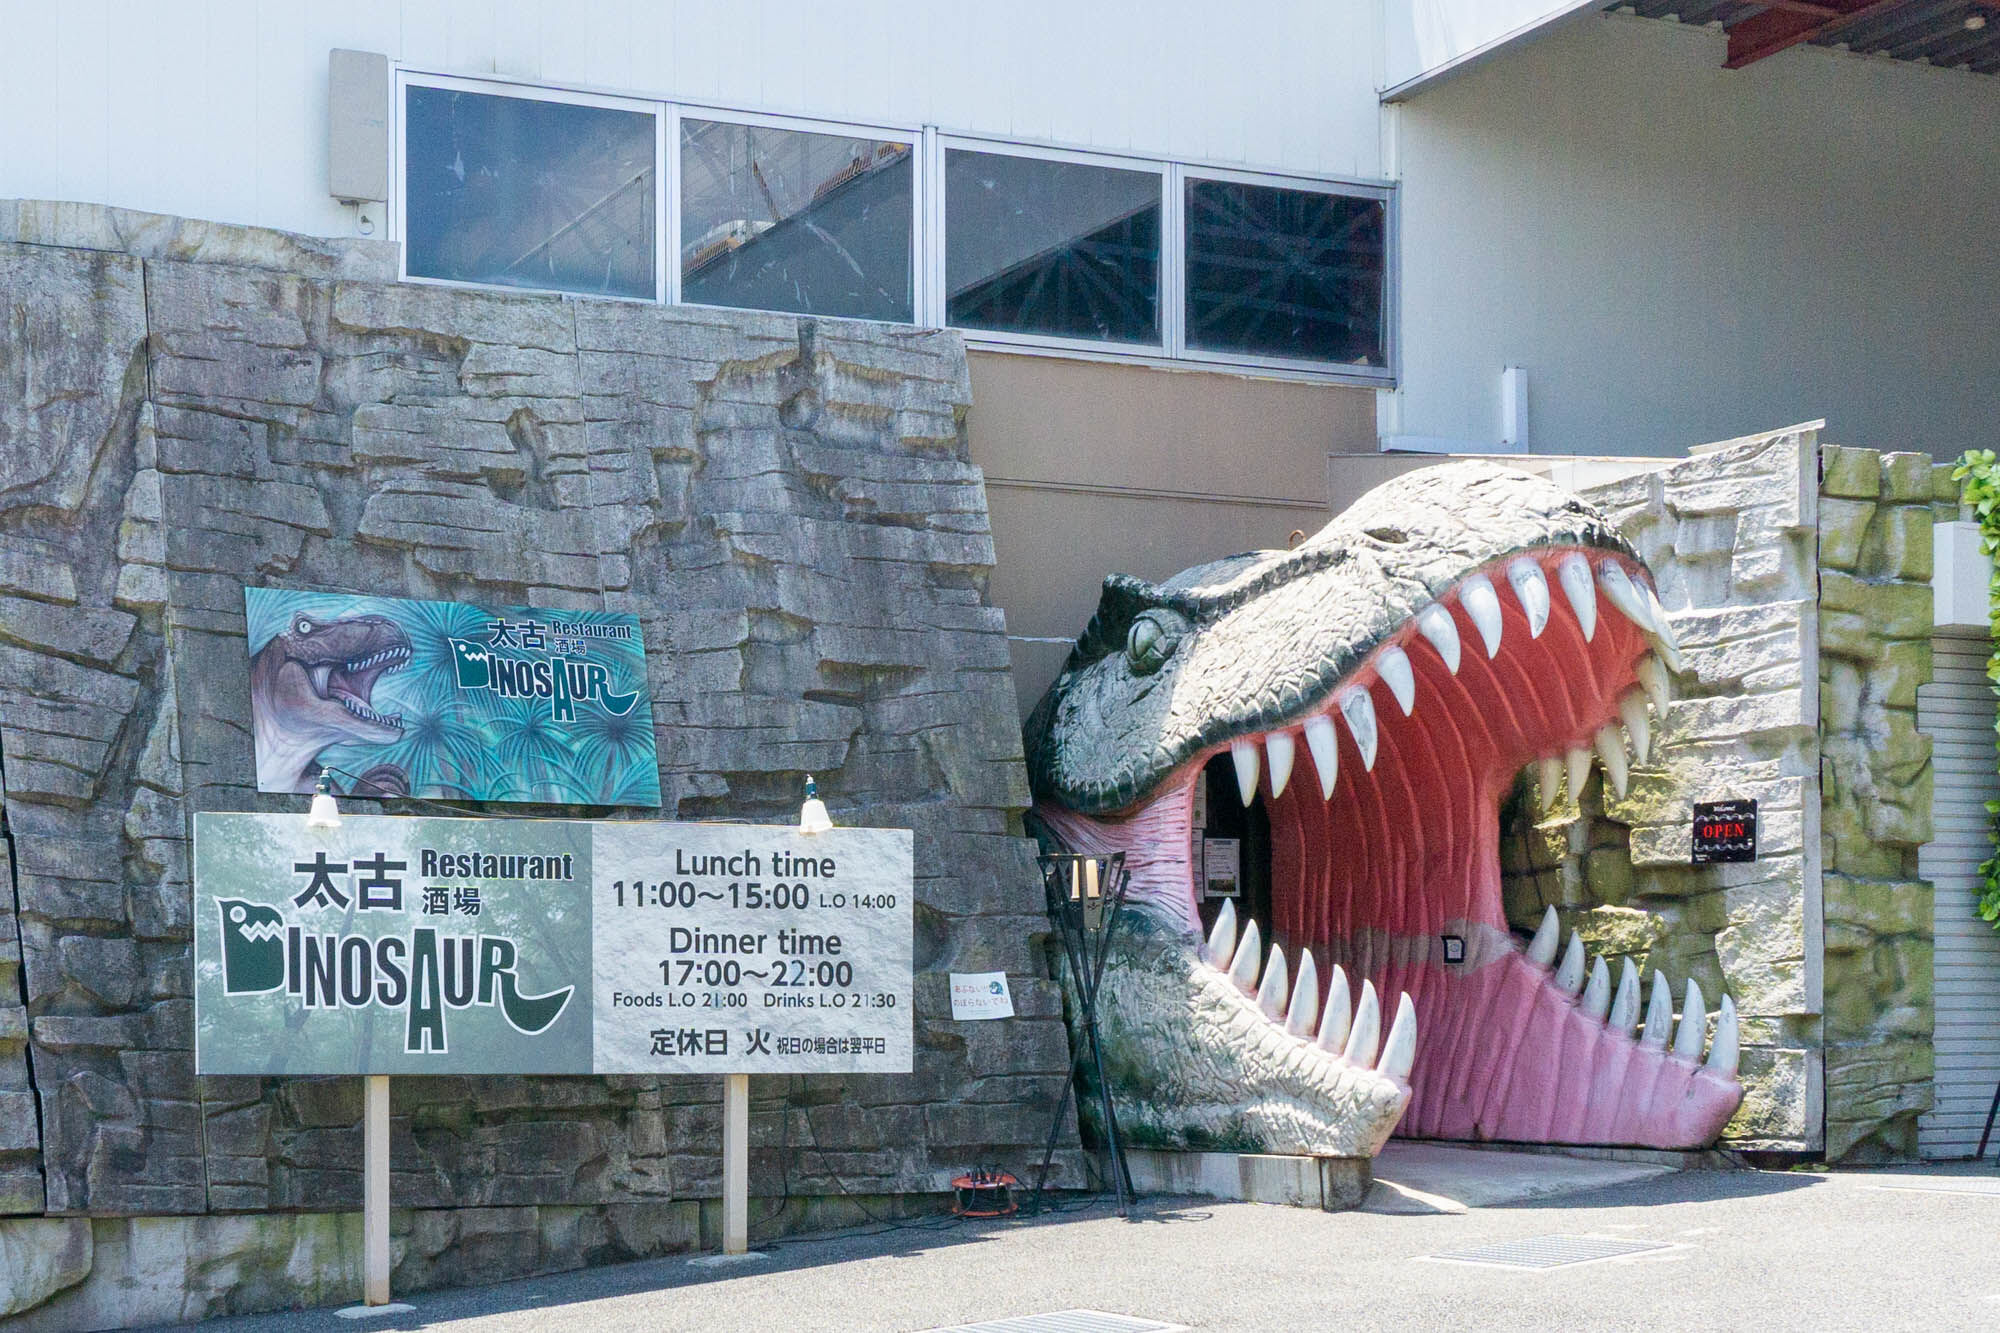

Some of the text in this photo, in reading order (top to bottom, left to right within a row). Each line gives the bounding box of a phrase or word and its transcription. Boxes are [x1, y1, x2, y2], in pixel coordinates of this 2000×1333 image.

[488, 619, 547, 651] 太古
[551, 620, 632, 639] Restaurant
[554, 638, 586, 655] 酒場
[448, 637, 639, 723] DINOSAUR
[1703, 823, 1745, 839] OPEN
[421, 849, 573, 880] Restaurant
[676, 849, 836, 878] Lunch time
[294, 851, 408, 911] 太古
[422, 886, 481, 916] 酒場
[819, 894, 846, 909] L.O
[854, 894, 896, 909] 14:00
[670, 927, 842, 955] Dinner time
[214, 896, 574, 1053] DINOSAUR
[613, 992, 747, 1008] Foods L.O 21:00
[764, 993, 896, 1008] Drinks L.O 21:30
[650, 1028, 885, 1056] 定休日 火 祝日の場合は翌平日
